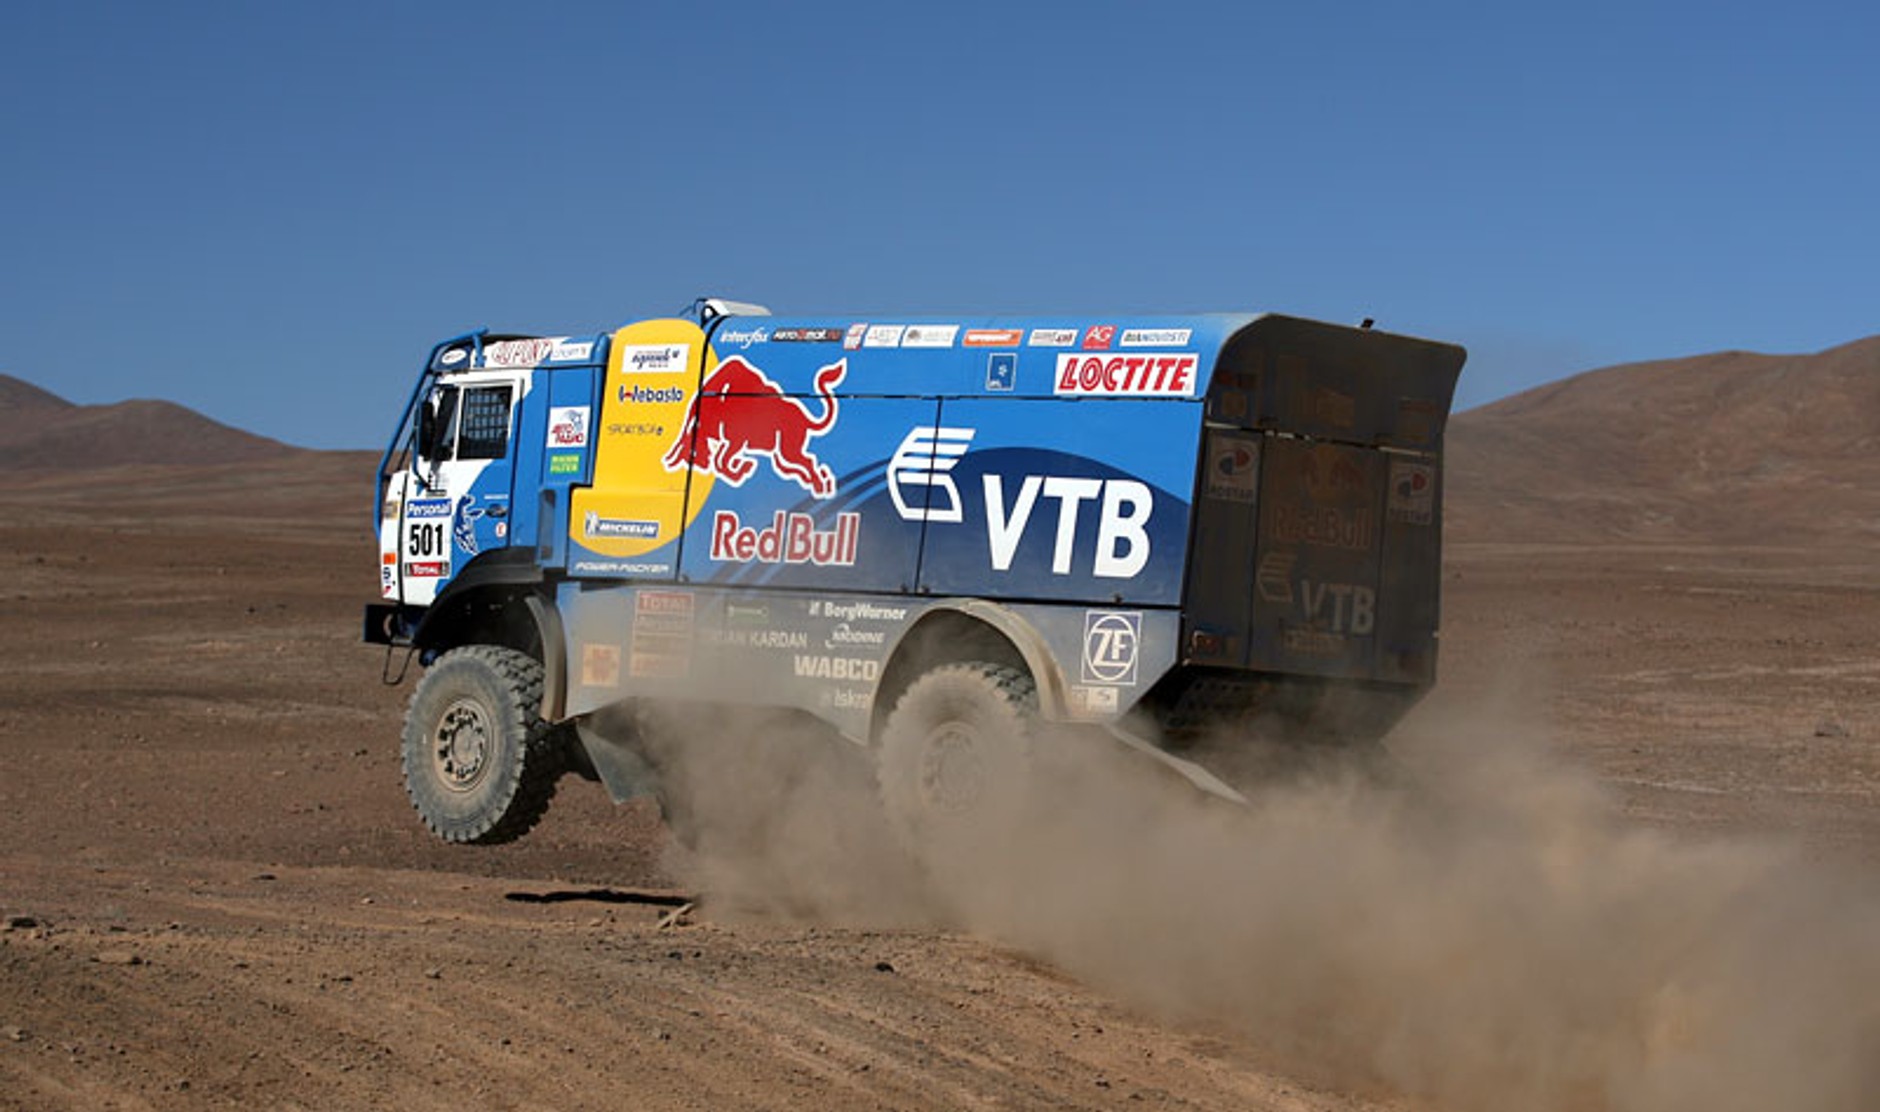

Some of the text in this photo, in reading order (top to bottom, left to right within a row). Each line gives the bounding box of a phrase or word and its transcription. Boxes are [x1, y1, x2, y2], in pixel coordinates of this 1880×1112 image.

[1058, 356, 1195, 392] LOCTITE
[409, 523, 444, 557] 501
[982, 473, 1155, 578] VTB
[824, 601, 907, 621] BorgWarner
[1300, 578, 1376, 636] VTB
[751, 631, 808, 649] KARDAN
[1090, 627, 1133, 667] ZF
[794, 654, 880, 681] WABCO
